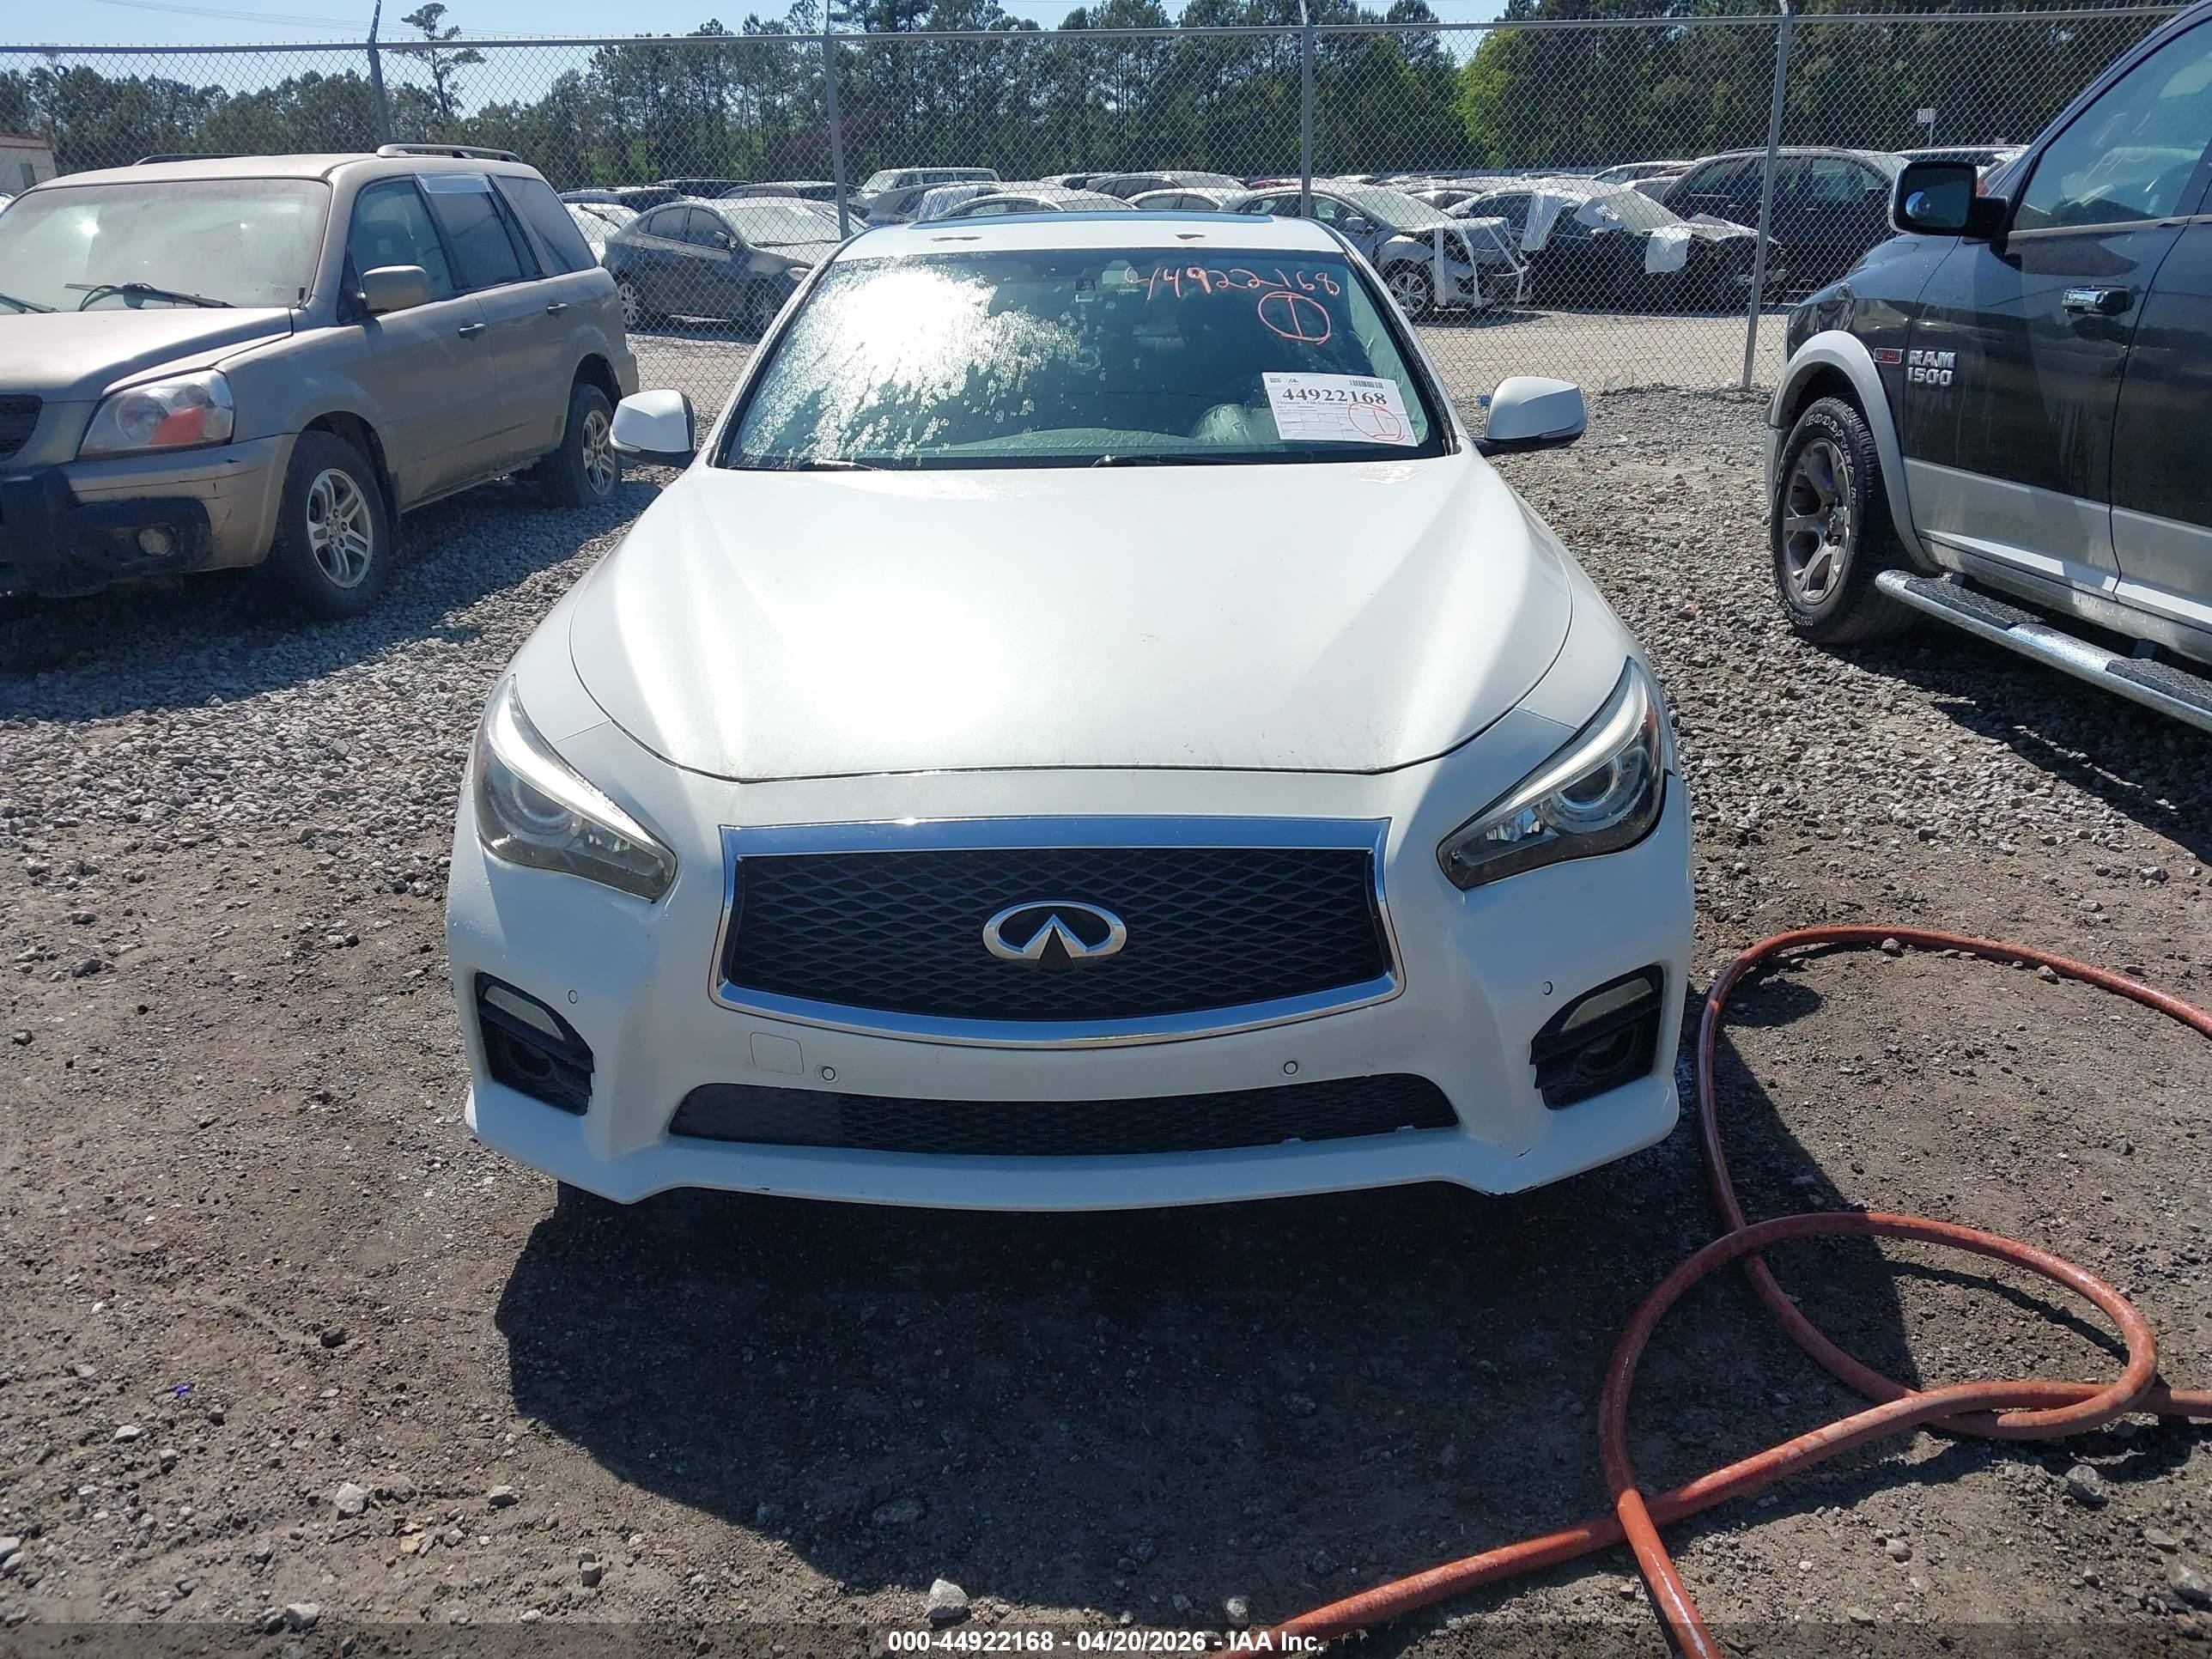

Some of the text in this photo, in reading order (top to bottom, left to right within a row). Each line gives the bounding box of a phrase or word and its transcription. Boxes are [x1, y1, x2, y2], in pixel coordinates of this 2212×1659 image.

[1124, 266, 1340, 302] 44922168
[1908, 349, 1957, 368] RAM
[1907, 367, 1953, 386] 1500
[1282, 388, 1388, 405] 44922168
